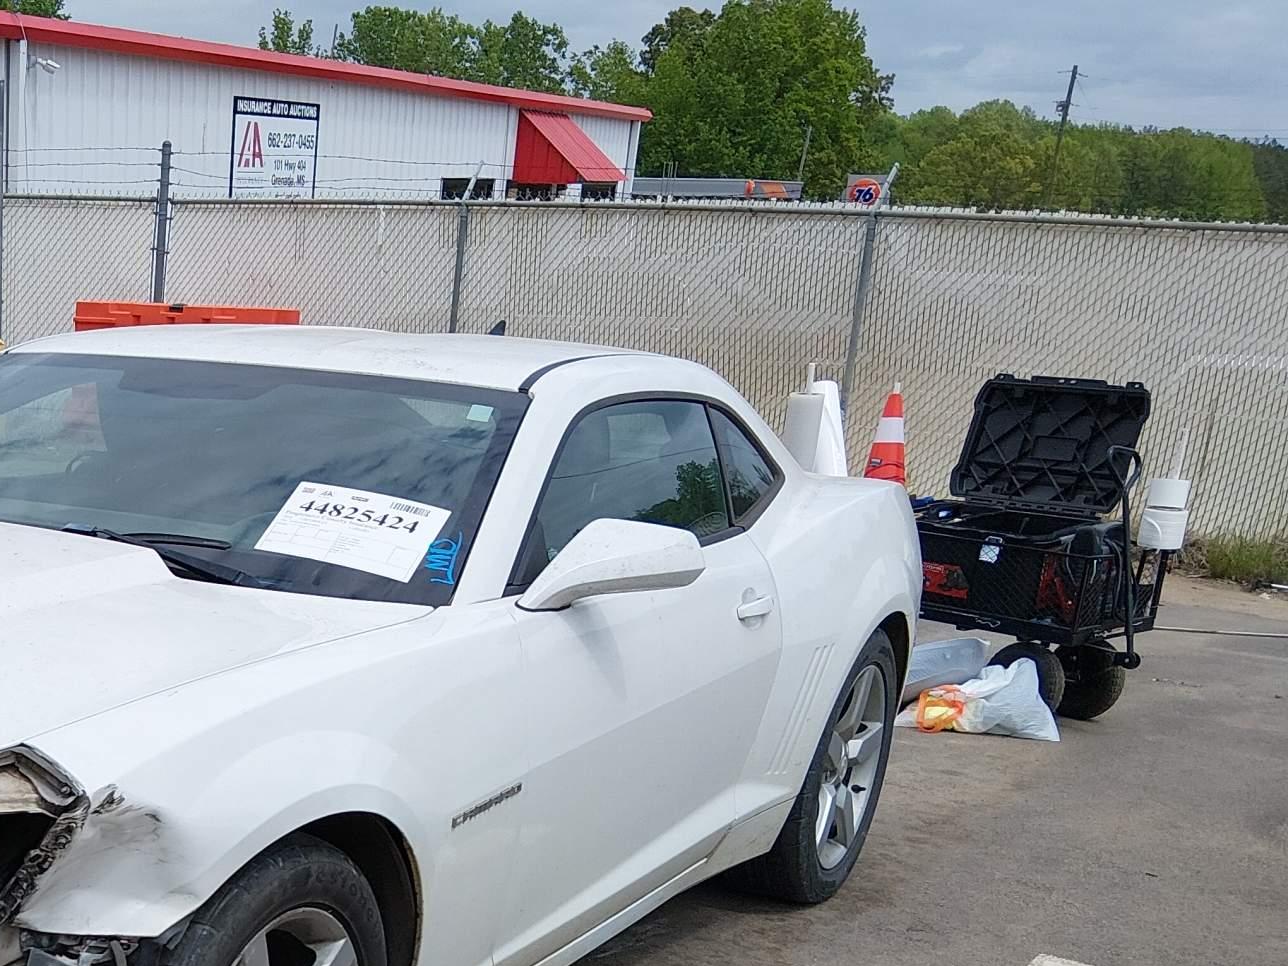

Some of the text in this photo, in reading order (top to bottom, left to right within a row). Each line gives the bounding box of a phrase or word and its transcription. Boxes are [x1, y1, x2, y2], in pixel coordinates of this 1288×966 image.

[237, 99, 318, 118] INSURANCE AUTO AUCTIONS
[267, 132, 315, 150] 662-237-0455
[274, 160, 283, 171] 101
[284, 160, 296, 175] Hwy
[296, 175, 306, 187] MS
[854, 187, 874, 203] 76
[299, 500, 420, 534] 44825424
